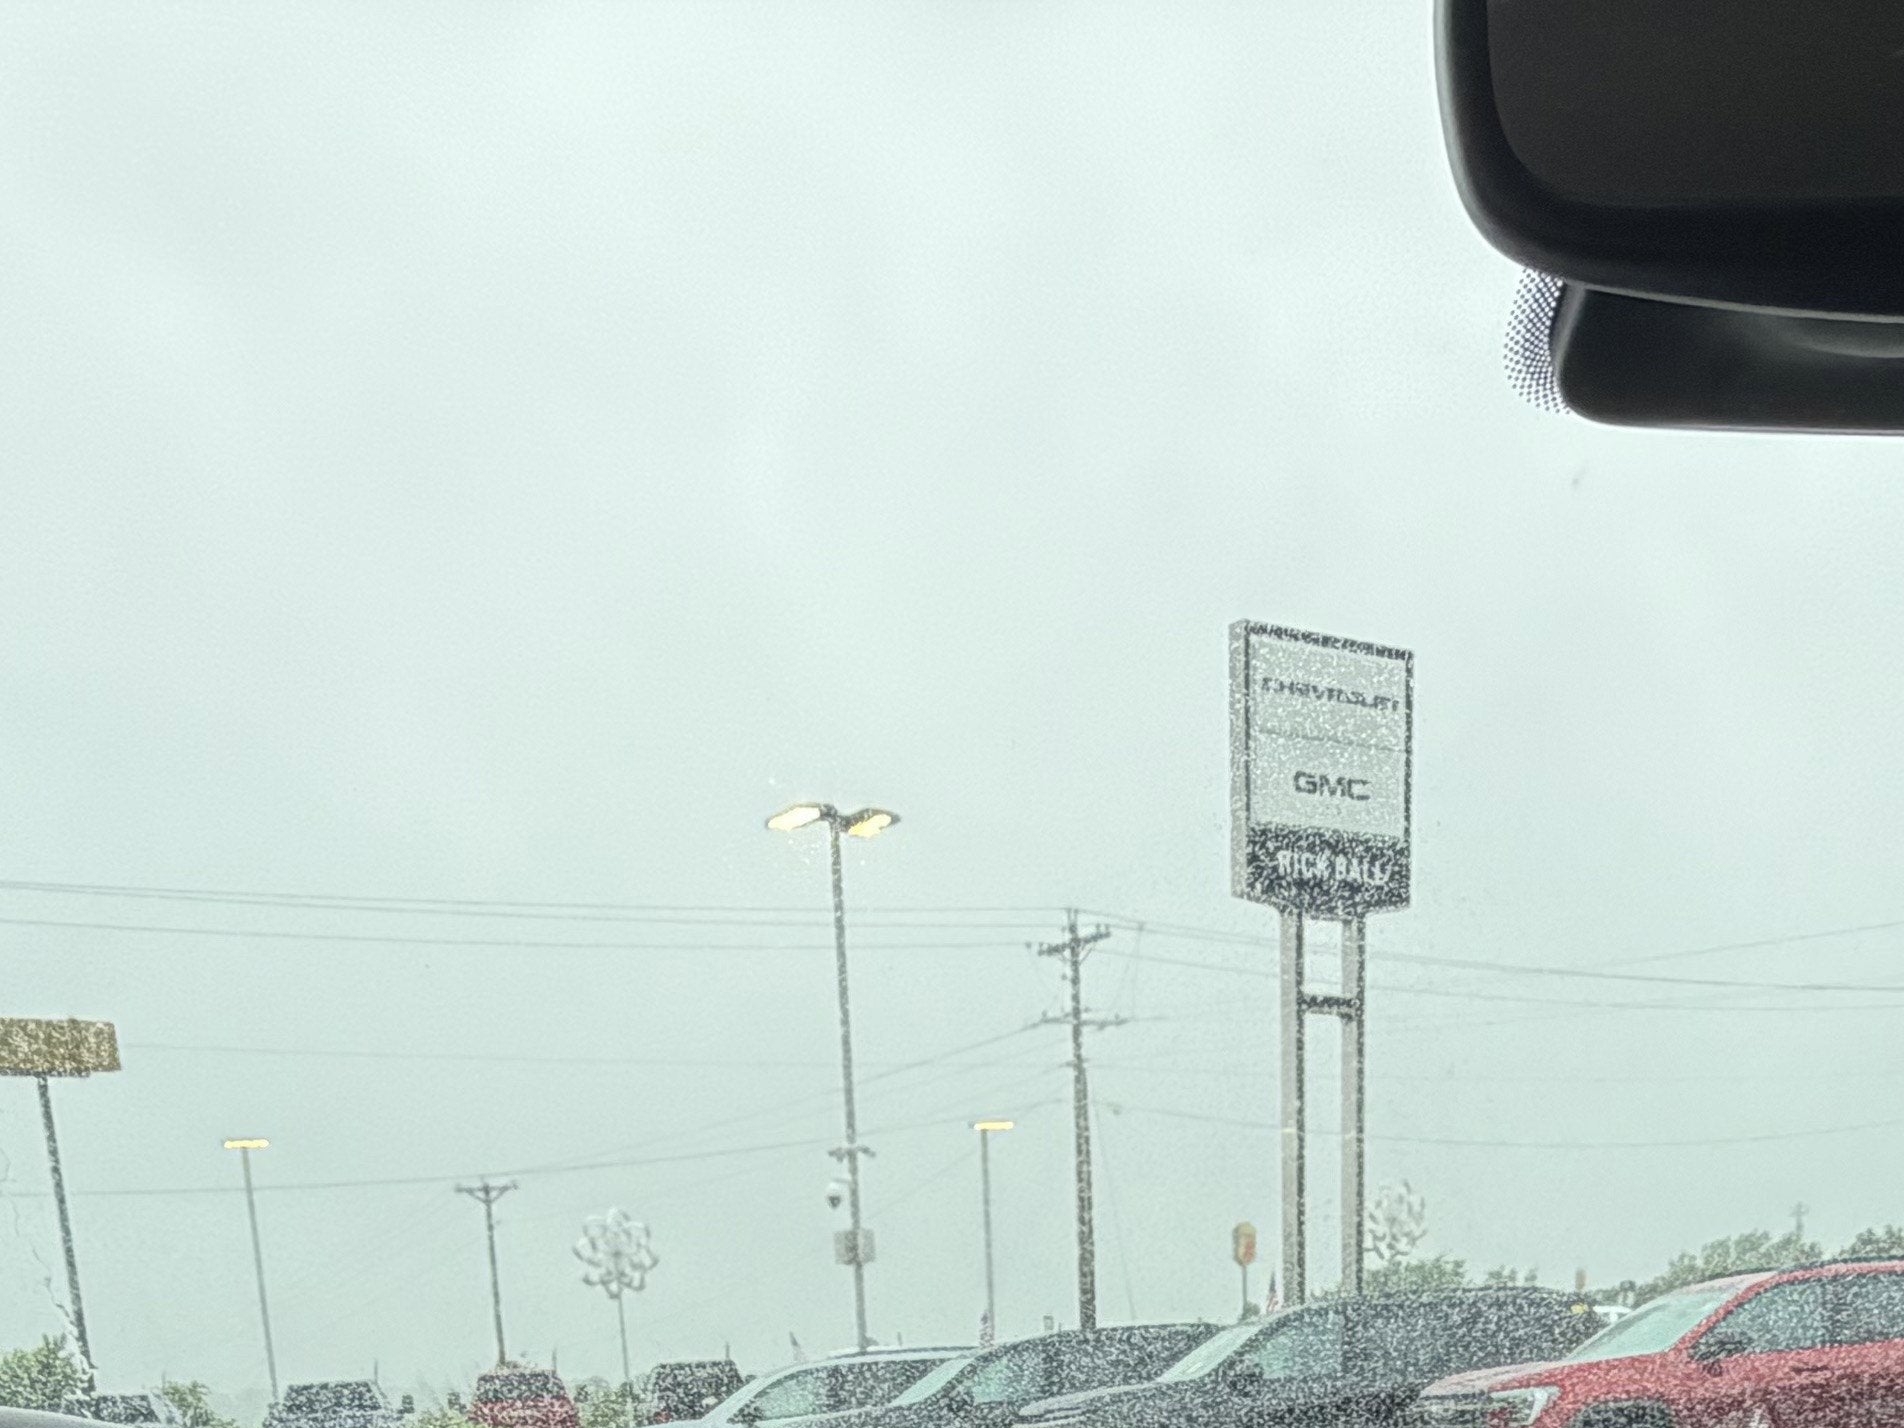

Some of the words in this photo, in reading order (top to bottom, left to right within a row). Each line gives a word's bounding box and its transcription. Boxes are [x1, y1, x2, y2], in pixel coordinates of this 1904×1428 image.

[1294, 771, 1371, 800] GMC
[1278, 850, 1330, 881] RICK
[1335, 856, 1392, 885] BALL
